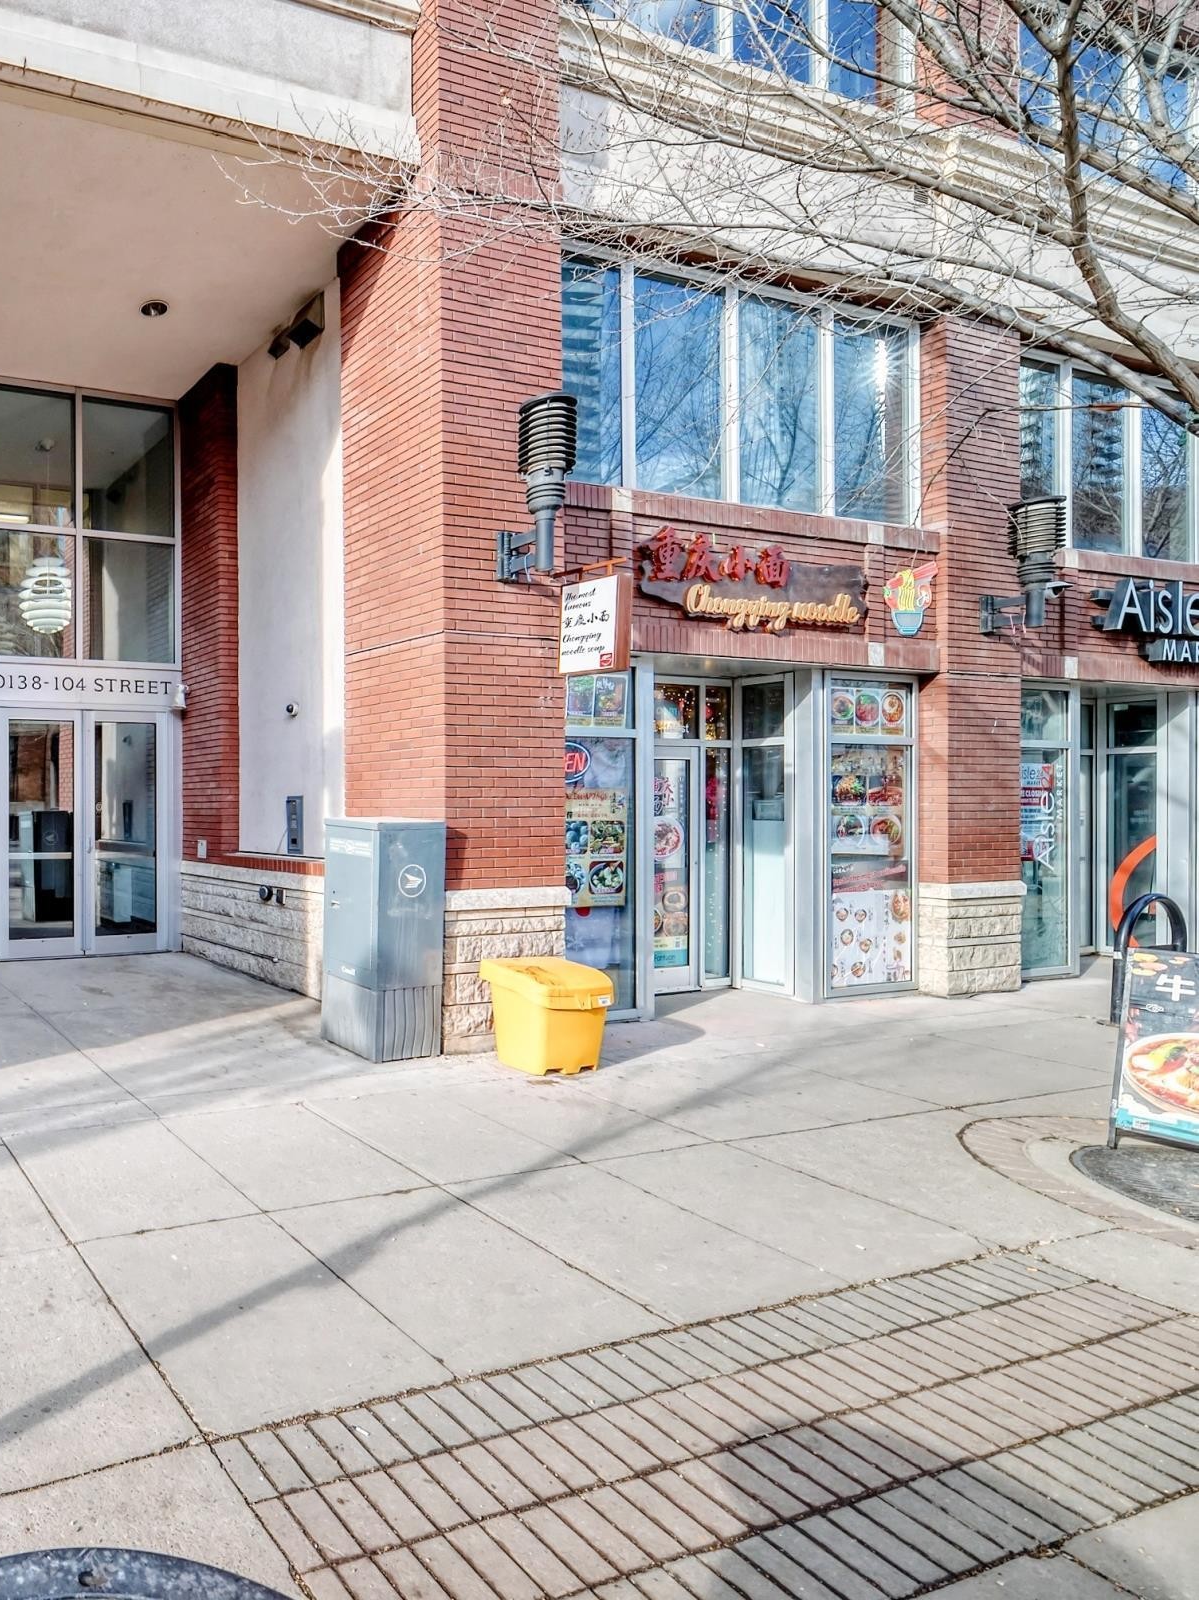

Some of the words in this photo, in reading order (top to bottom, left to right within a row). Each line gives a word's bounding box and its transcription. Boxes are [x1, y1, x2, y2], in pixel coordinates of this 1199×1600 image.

[648, 525, 790, 589] 重庆小面
[686, 584, 791, 632] Chongqing
[791, 593, 860, 624] noodle
[94, 678, 172, 696] STREET
[1055, 763, 1064, 820] MARKET
[1155, 974, 1197, 1001] 牛
